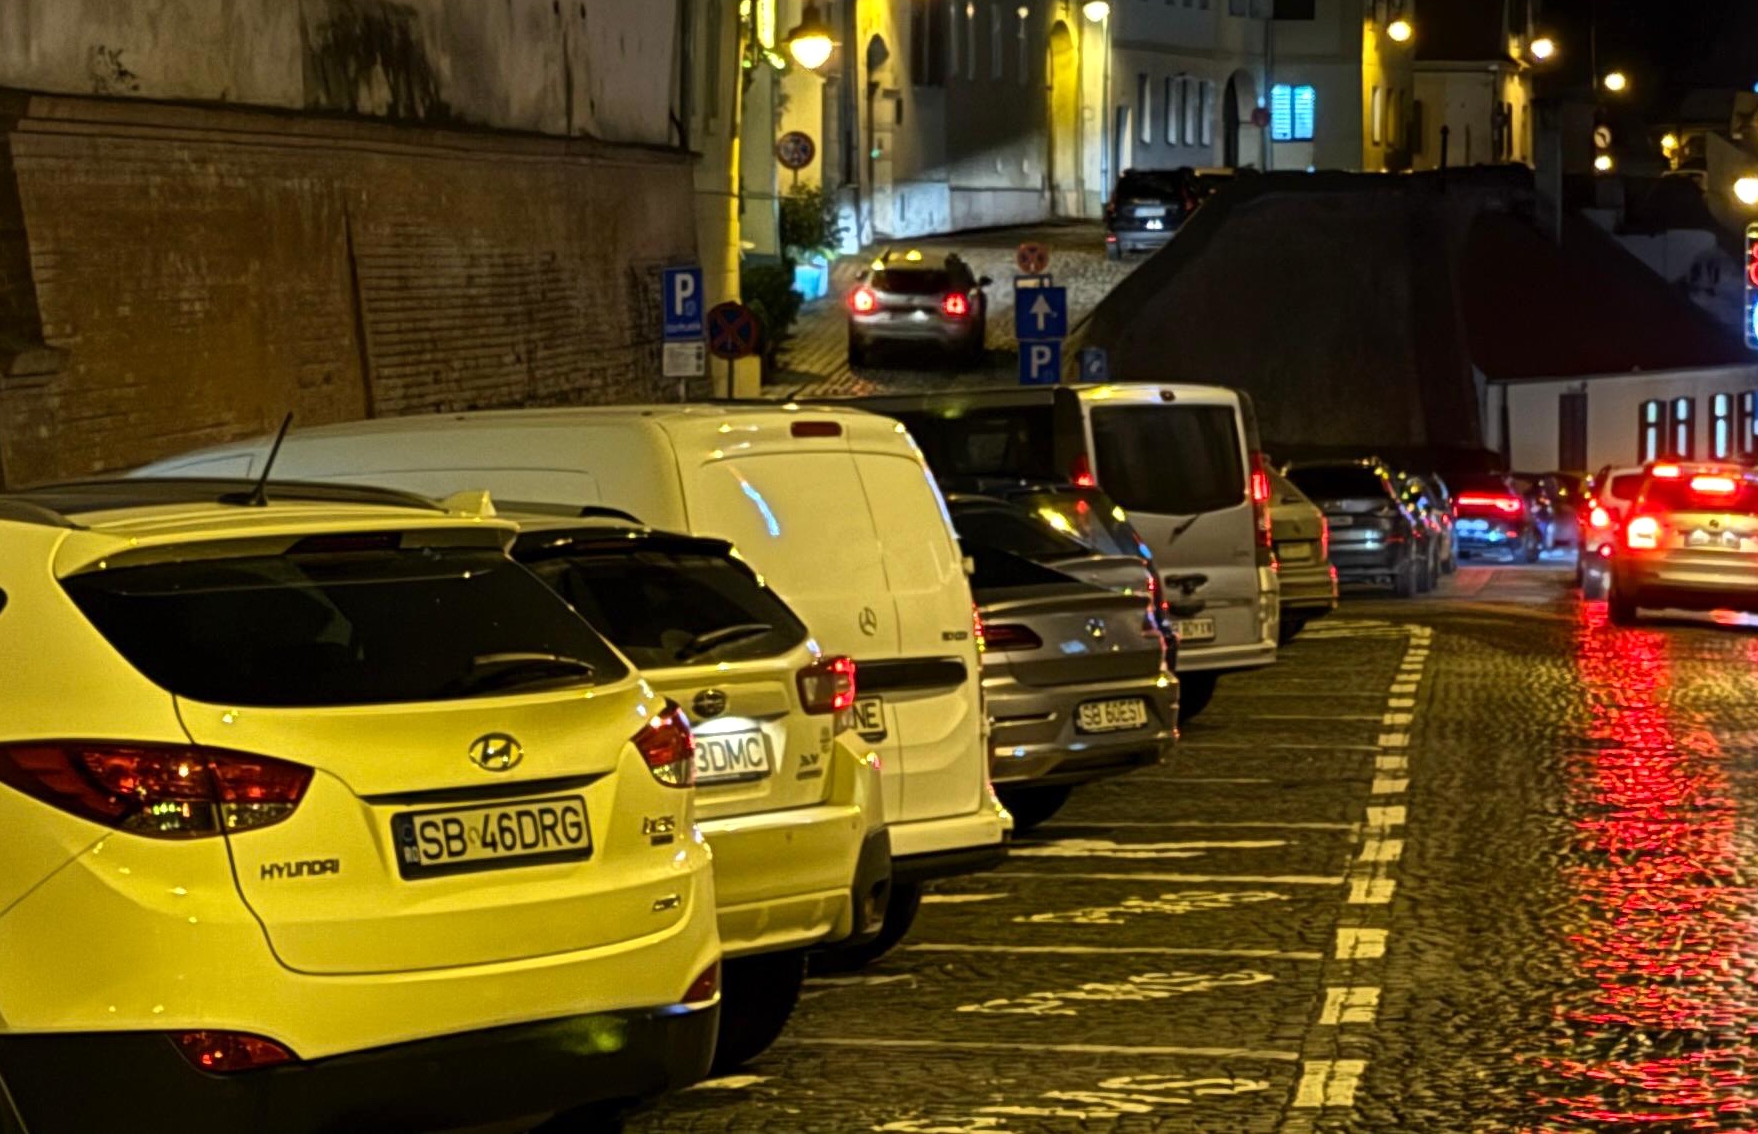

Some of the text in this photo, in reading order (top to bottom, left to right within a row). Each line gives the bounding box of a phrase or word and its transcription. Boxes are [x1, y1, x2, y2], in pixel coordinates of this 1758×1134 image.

[674, 272, 695, 316] P
[1030, 345, 1052, 379] P
[1083, 704, 1103, 726] SB
[419, 805, 584, 860] SB 46DRG
[261, 858, 340, 881] HYUNDAI
